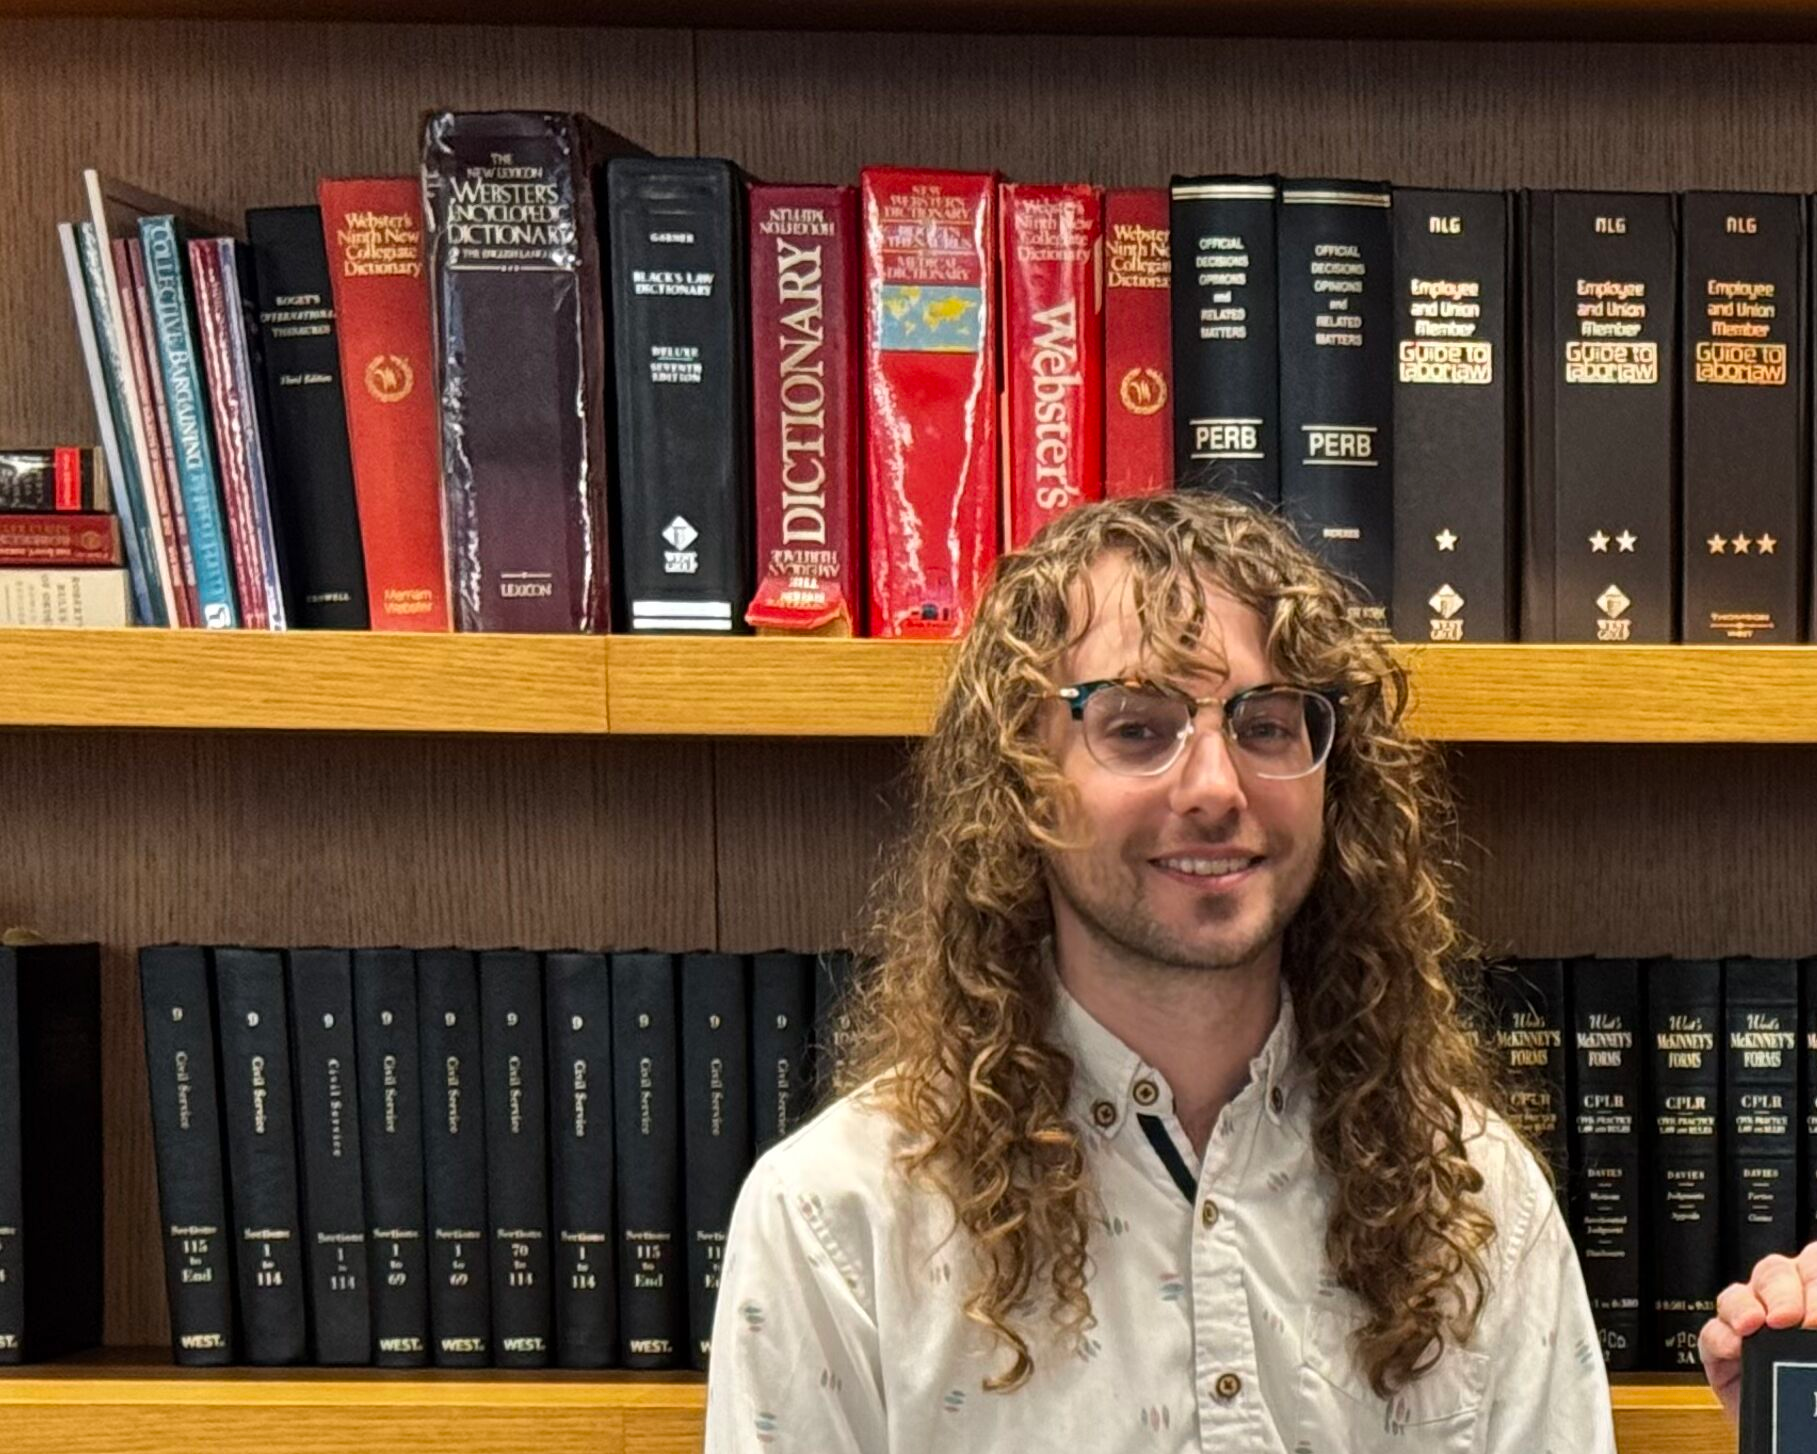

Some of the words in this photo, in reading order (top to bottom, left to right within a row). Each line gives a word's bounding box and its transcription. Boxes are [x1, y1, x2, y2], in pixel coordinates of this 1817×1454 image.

[450, 176, 559, 204] WEBSTER'S
[448, 223, 575, 244] DICTIONARY
[1199, 237, 1244, 250] OFFICIAL
[1315, 245, 1360, 258] OFFICIAL
[1196, 255, 1249, 268] DECISIONS
[1311, 262, 1366, 276] DECISIONS
[1198, 273, 1247, 286] OPINIONS
[1314, 279, 1363, 293] OPINIONS
[635, 283, 713, 296] DICTIONARY
[1410, 278, 1479, 300] Employee
[1577, 279, 1645, 300] Employee
[1707, 279, 1775, 300] Employee
[1200, 308, 1246, 321] RELATED
[1410, 302, 1438, 317] and
[1440, 301, 1480, 317] Union
[1577, 302, 1604, 317] and
[1606, 301, 1646, 317] Union
[1707, 302, 1734, 317] and
[1736, 302, 1775, 318] Union
[1200, 326, 1247, 339] MATTERS
[1415, 320, 1476, 336] Member
[1581, 320, 1642, 336] Member
[1712, 321, 1770, 337] Member
[777, 237, 826, 545] DICTIONARY
[1031, 297, 1084, 511] Webster's
[1196, 426, 1257, 450] PERB
[1309, 432, 1372, 457] PERB
[501, 583, 552, 597] LEXICON
[1584, 1095, 1624, 1109] CPLR
[1665, 1096, 1706, 1110] CPLR
[1741, 1095, 1782, 1109] CPLR
